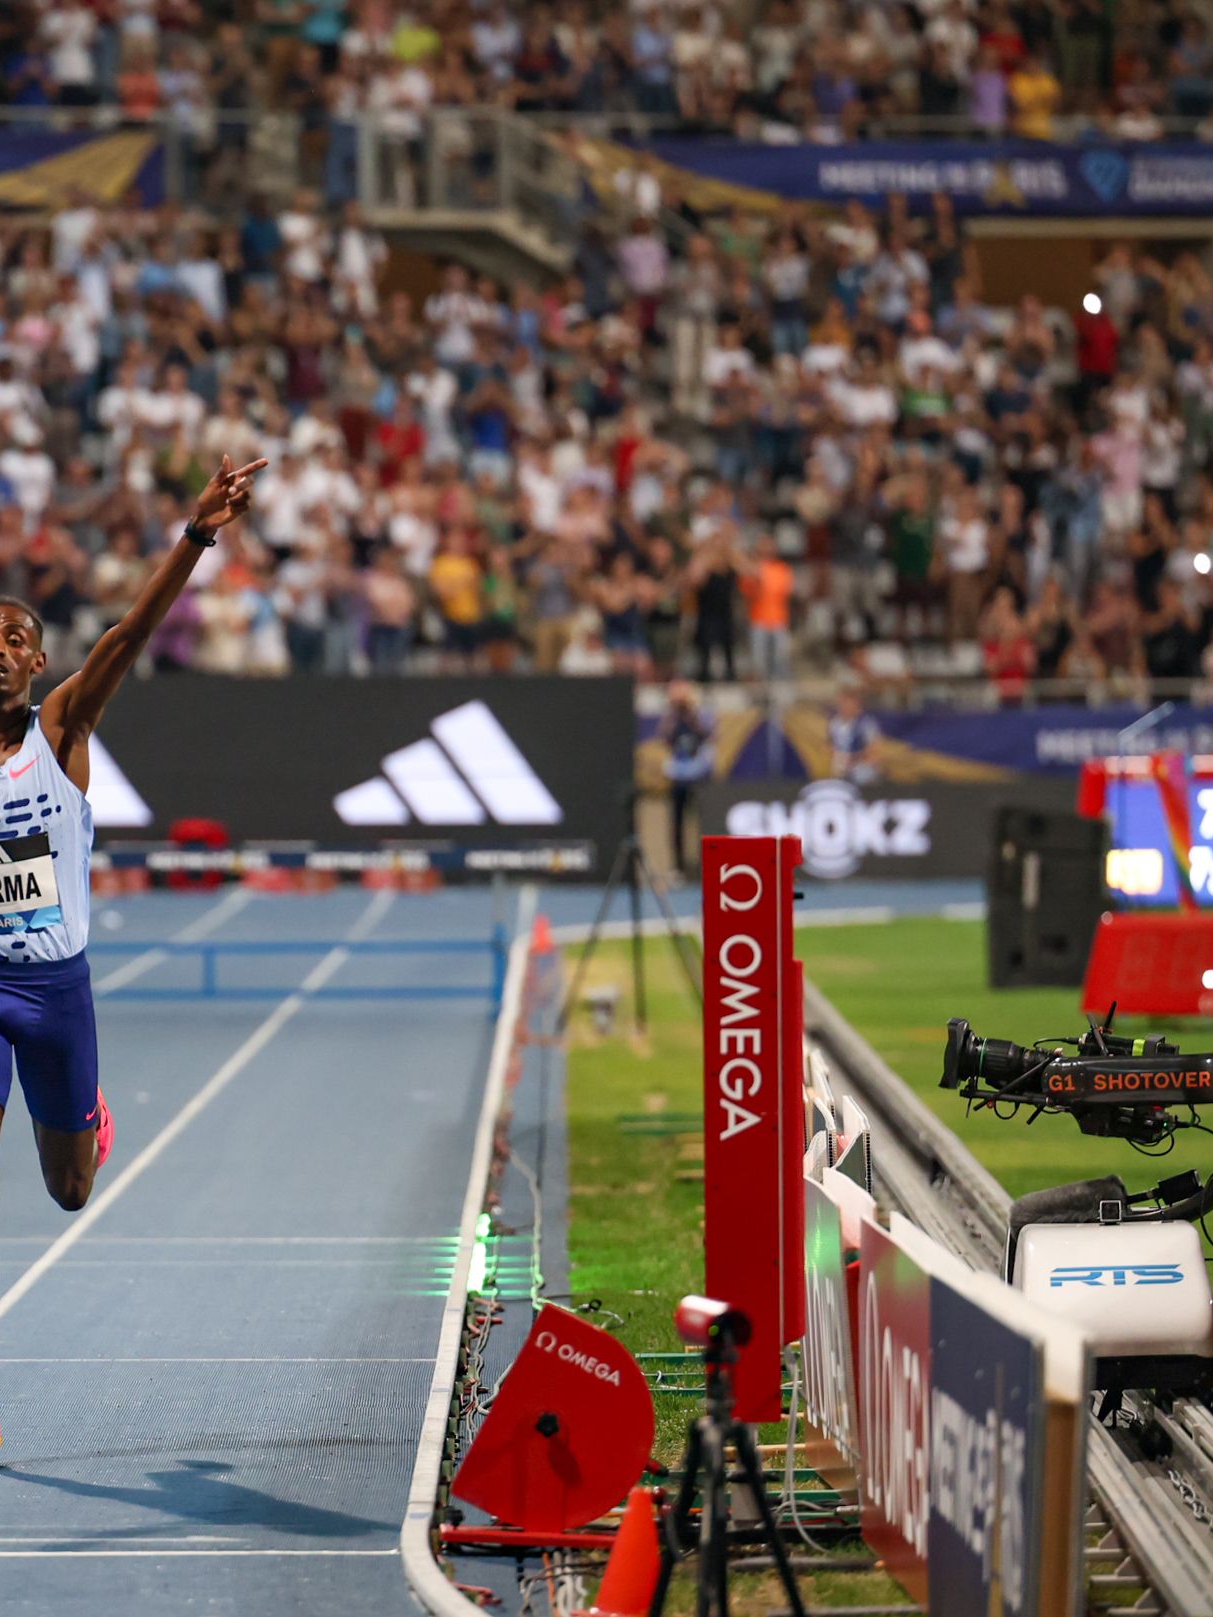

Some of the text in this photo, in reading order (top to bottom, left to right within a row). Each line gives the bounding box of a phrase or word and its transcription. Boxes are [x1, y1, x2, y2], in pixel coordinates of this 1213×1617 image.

[719, 934, 762, 1141] OMEGA
[1048, 1071, 1211, 1091] G1 SHOTOVER
[1050, 1263, 1184, 1287] RTS
[558, 1344, 620, 1387] OMEGA
